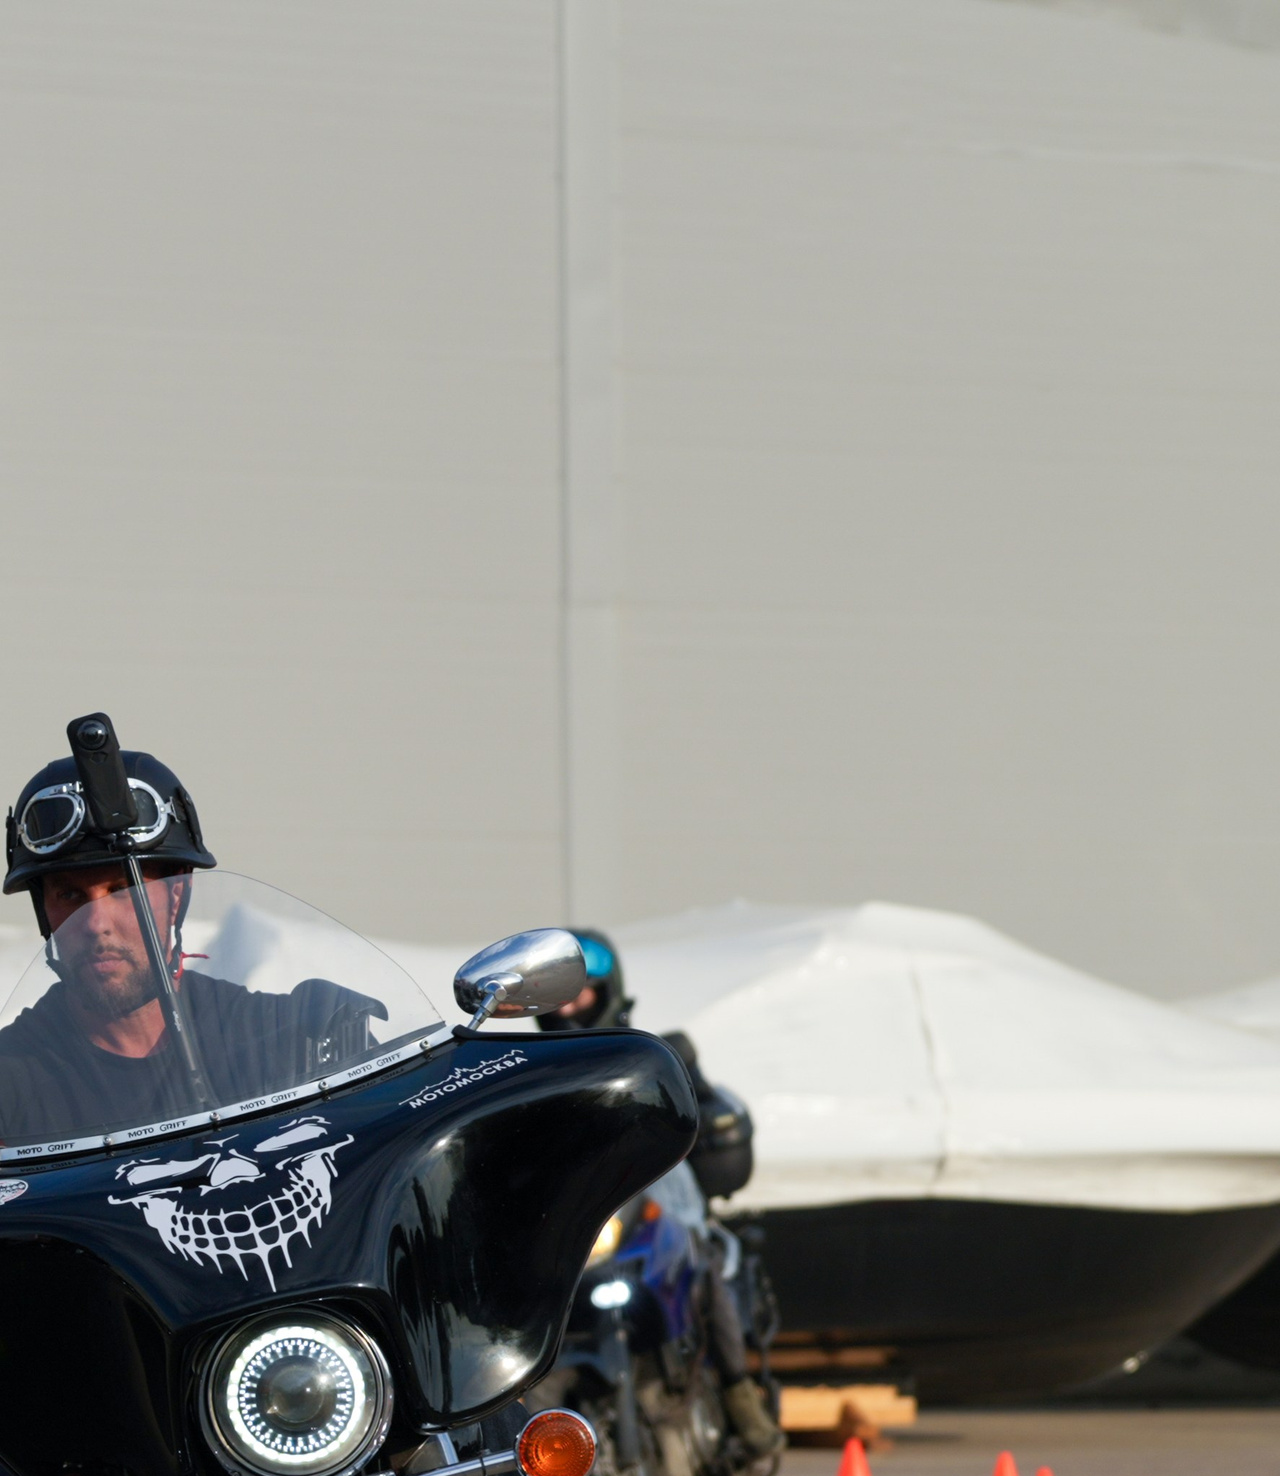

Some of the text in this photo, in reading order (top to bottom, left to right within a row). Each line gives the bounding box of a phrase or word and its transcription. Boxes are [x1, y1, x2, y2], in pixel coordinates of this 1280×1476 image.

[347, 1064, 373, 1078] MOTO
[409, 1056, 528, 1109] МОТОМОСКВА
[240, 1099, 266, 1111] MOTO
[128, 1127, 154, 1138] MOTO
[17, 1147, 43, 1156] MOTO
